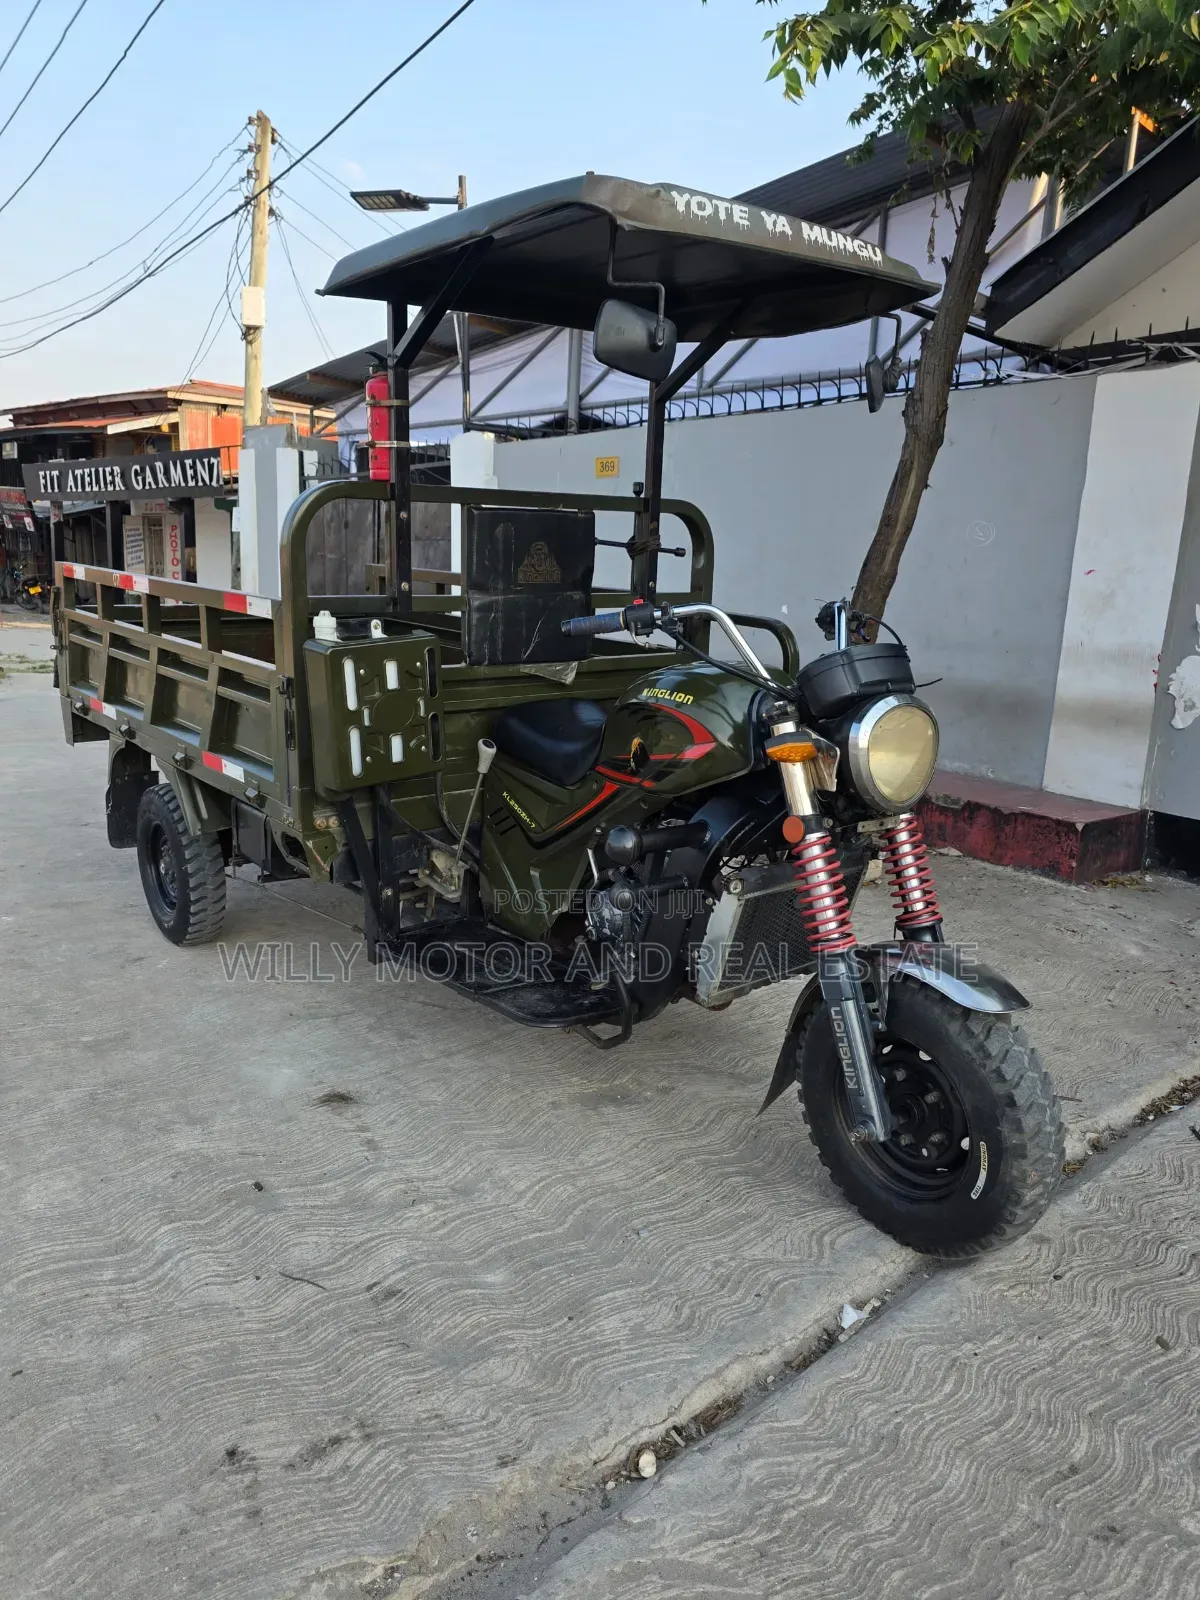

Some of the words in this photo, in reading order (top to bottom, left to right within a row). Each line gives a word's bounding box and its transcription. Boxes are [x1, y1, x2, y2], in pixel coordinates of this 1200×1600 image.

[670, 191, 750, 230] YOTE
[761, 211, 793, 241] YA
[801, 221, 884, 267] MUNGU
[38, 470, 59, 493] FIT
[66, 465, 125, 493] ATELIER
[599, 460, 615, 472] 369
[169, 524, 180, 567] PHOTO
[641, 688, 694, 705] KINGLION
[831, 1006, 858, 1089] KINGLION
